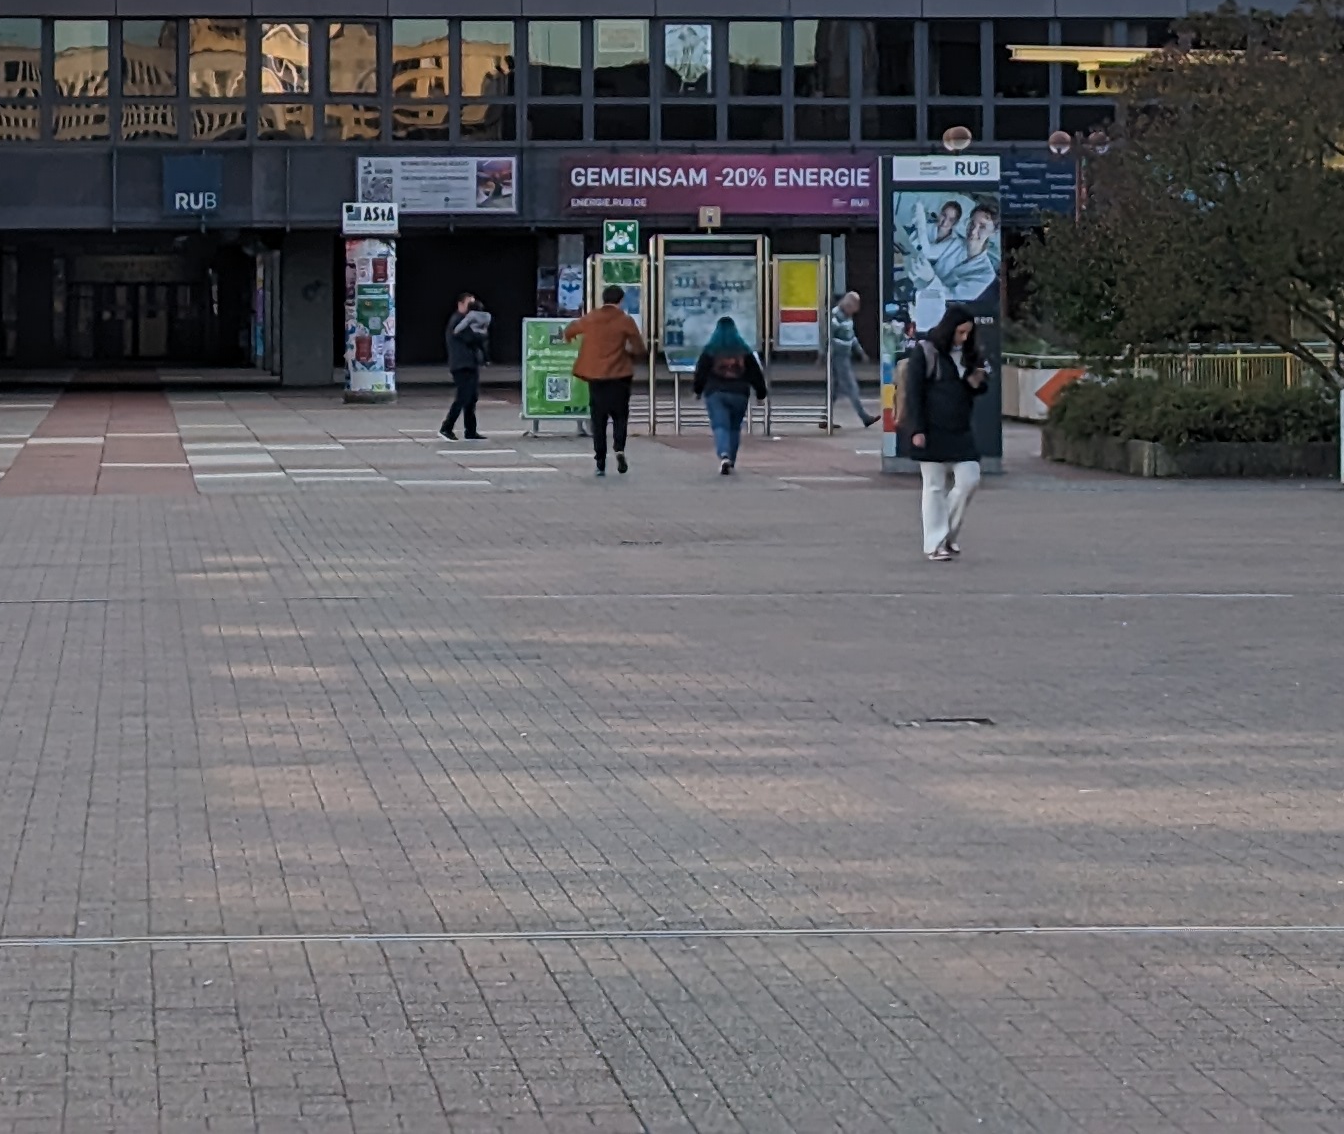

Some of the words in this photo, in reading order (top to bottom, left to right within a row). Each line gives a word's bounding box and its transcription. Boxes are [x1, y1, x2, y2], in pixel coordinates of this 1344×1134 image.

[570, 167, 708, 187] GEMEINSAM
[714, 167, 767, 187] -20%
[774, 167, 871, 187] ENERGIE
[954, 161, 990, 176] RUB
[174, 191, 217, 211] RUB
[363, 206, 395, 222] AStA
